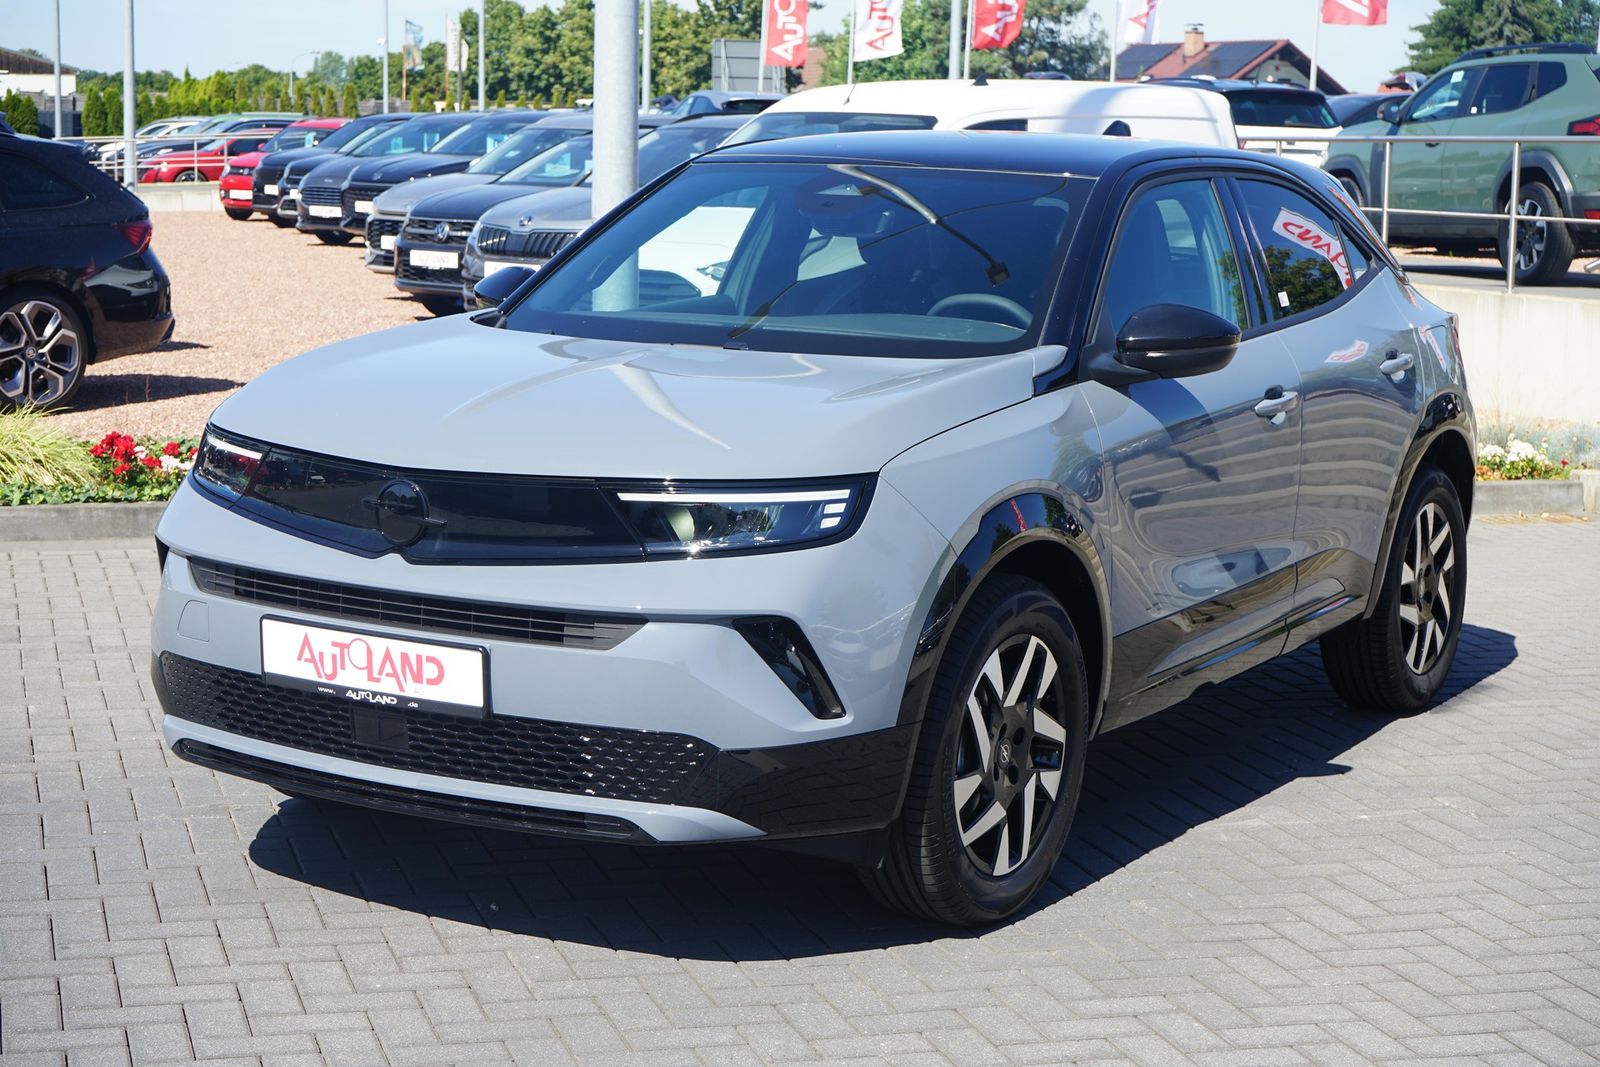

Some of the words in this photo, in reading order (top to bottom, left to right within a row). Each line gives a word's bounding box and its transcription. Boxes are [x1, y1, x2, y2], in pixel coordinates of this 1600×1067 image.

[864, 0, 894, 51] AUT
[297, 632, 445, 692] AUTOLAND
[345, 689, 398, 705] AUTOLAND
